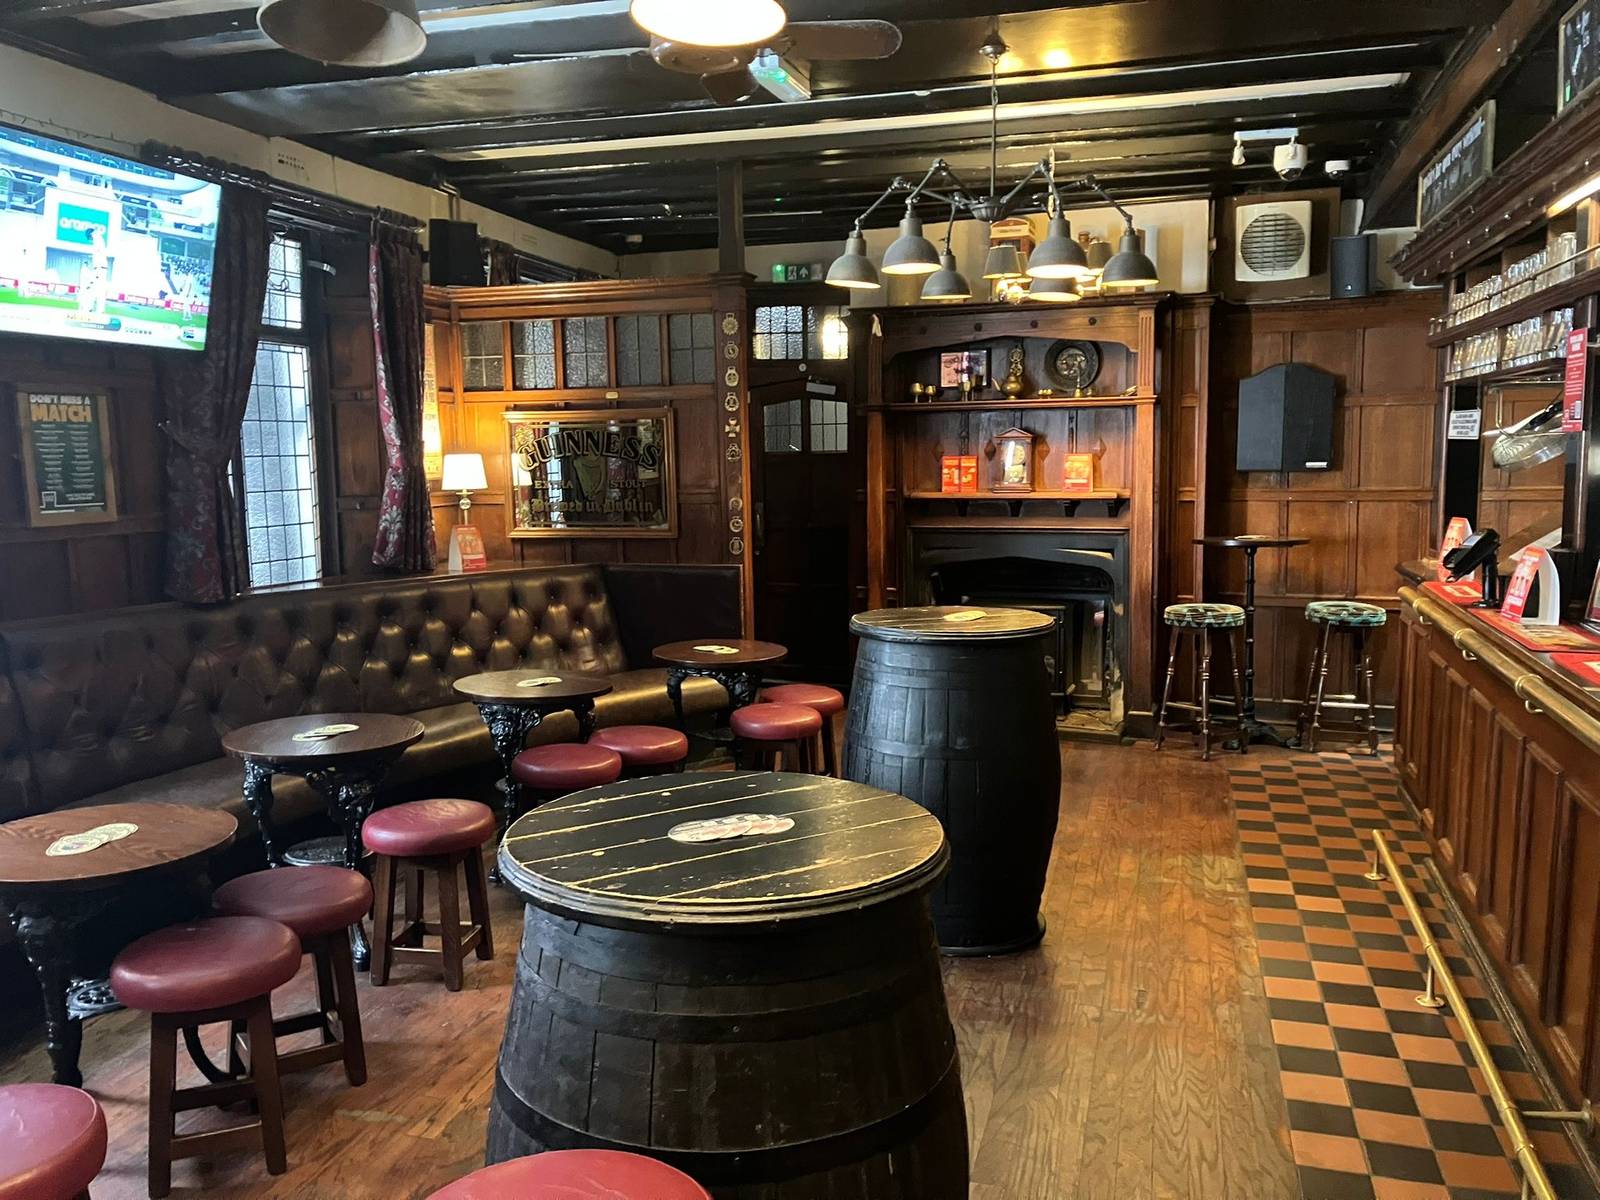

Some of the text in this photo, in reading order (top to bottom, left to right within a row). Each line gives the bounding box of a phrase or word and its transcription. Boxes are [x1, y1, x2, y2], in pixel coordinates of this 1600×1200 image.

[84, 396, 91, 405] A
[31, 404, 93, 422] MATCH
[516, 430, 663, 472] GUINNESS
[609, 480, 648, 489] STOUT
